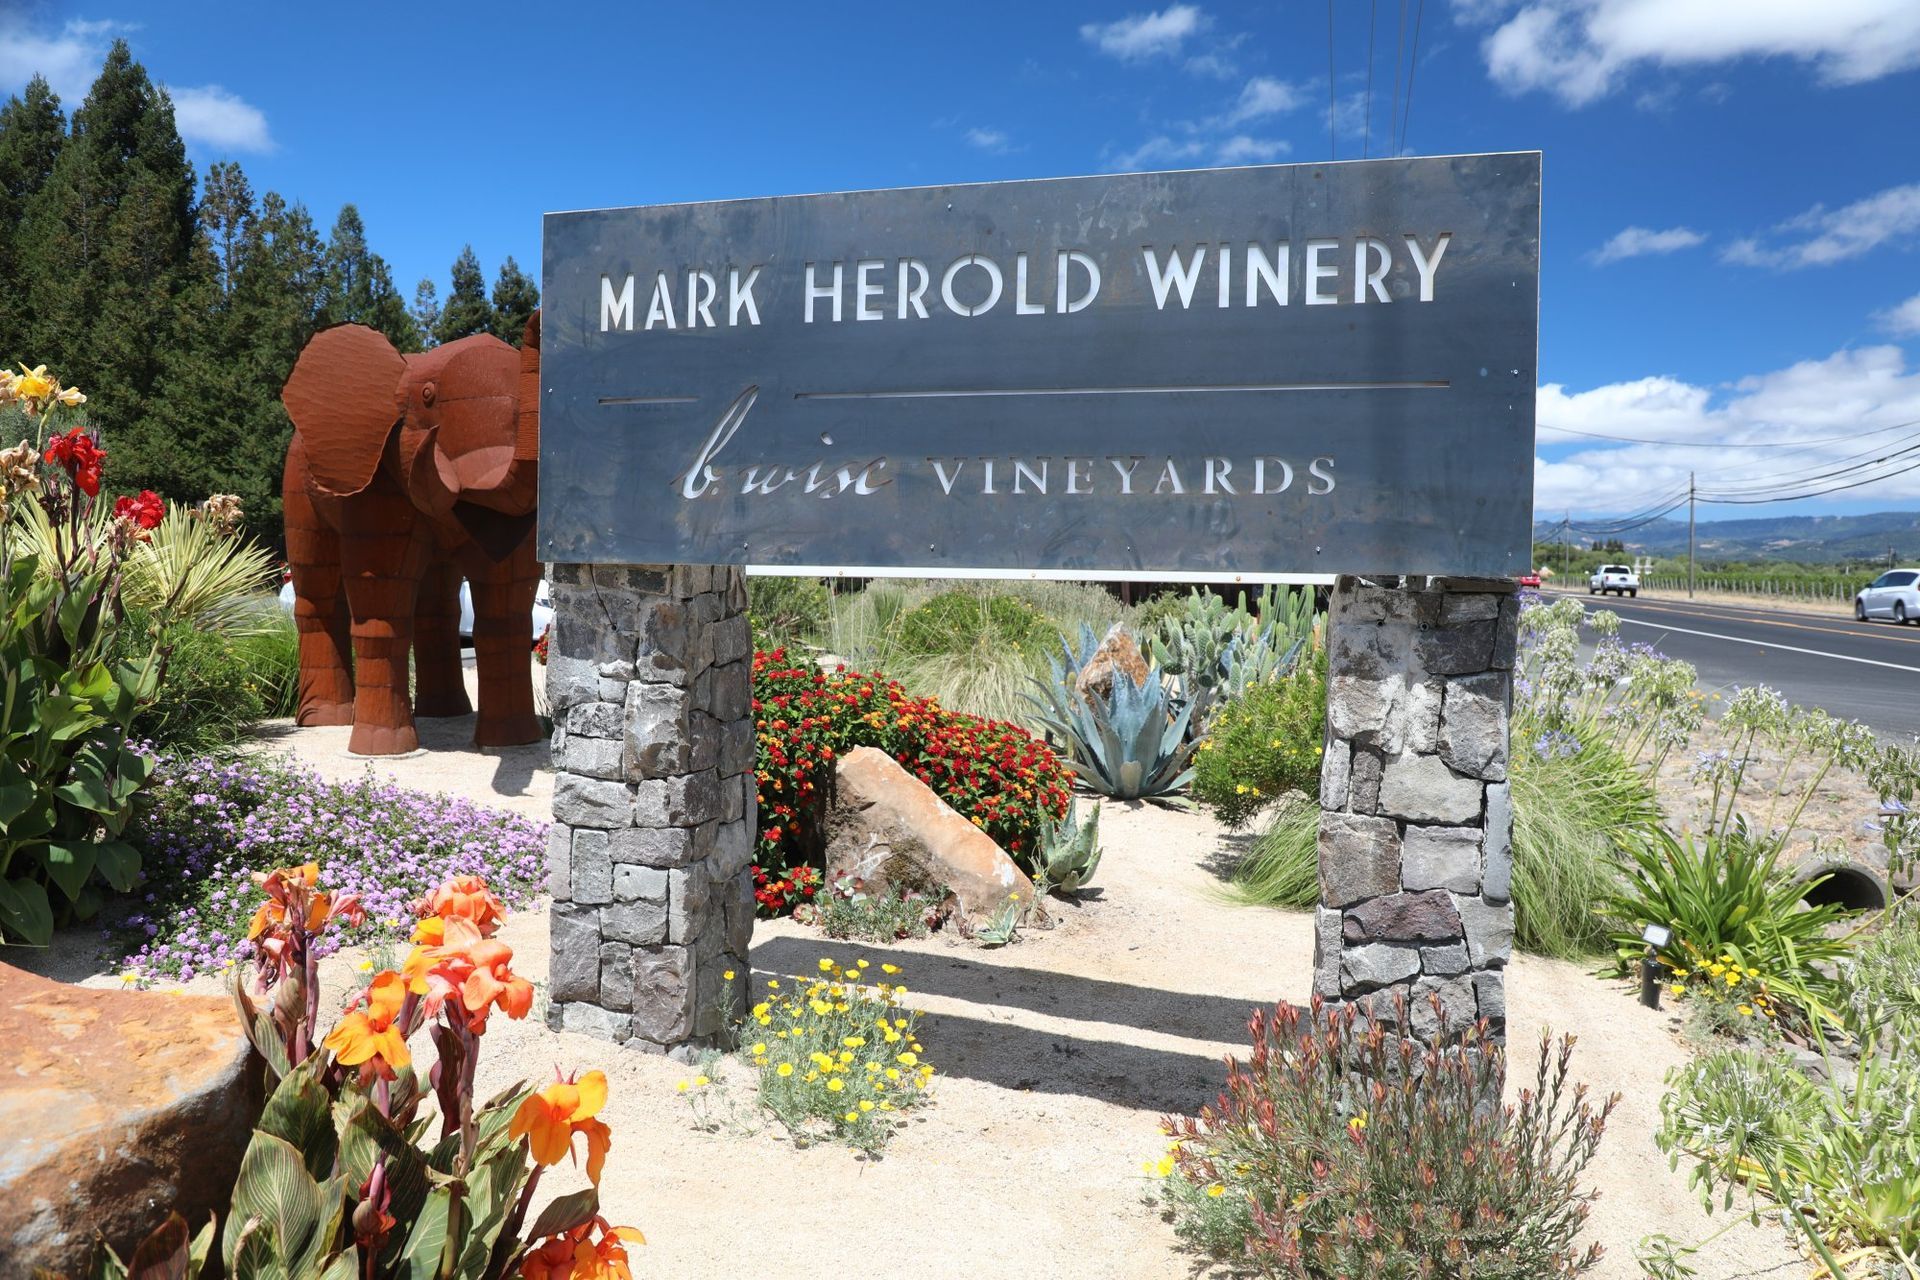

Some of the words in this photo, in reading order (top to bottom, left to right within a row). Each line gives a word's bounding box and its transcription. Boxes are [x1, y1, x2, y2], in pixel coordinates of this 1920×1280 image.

[600, 264, 764, 332] MARK
[804, 249, 1101, 323] HEROLD
[1141, 232, 1453, 310] WINERY
[738, 431, 893, 499] wise
[926, 456, 1336, 496] VINEYARDS
